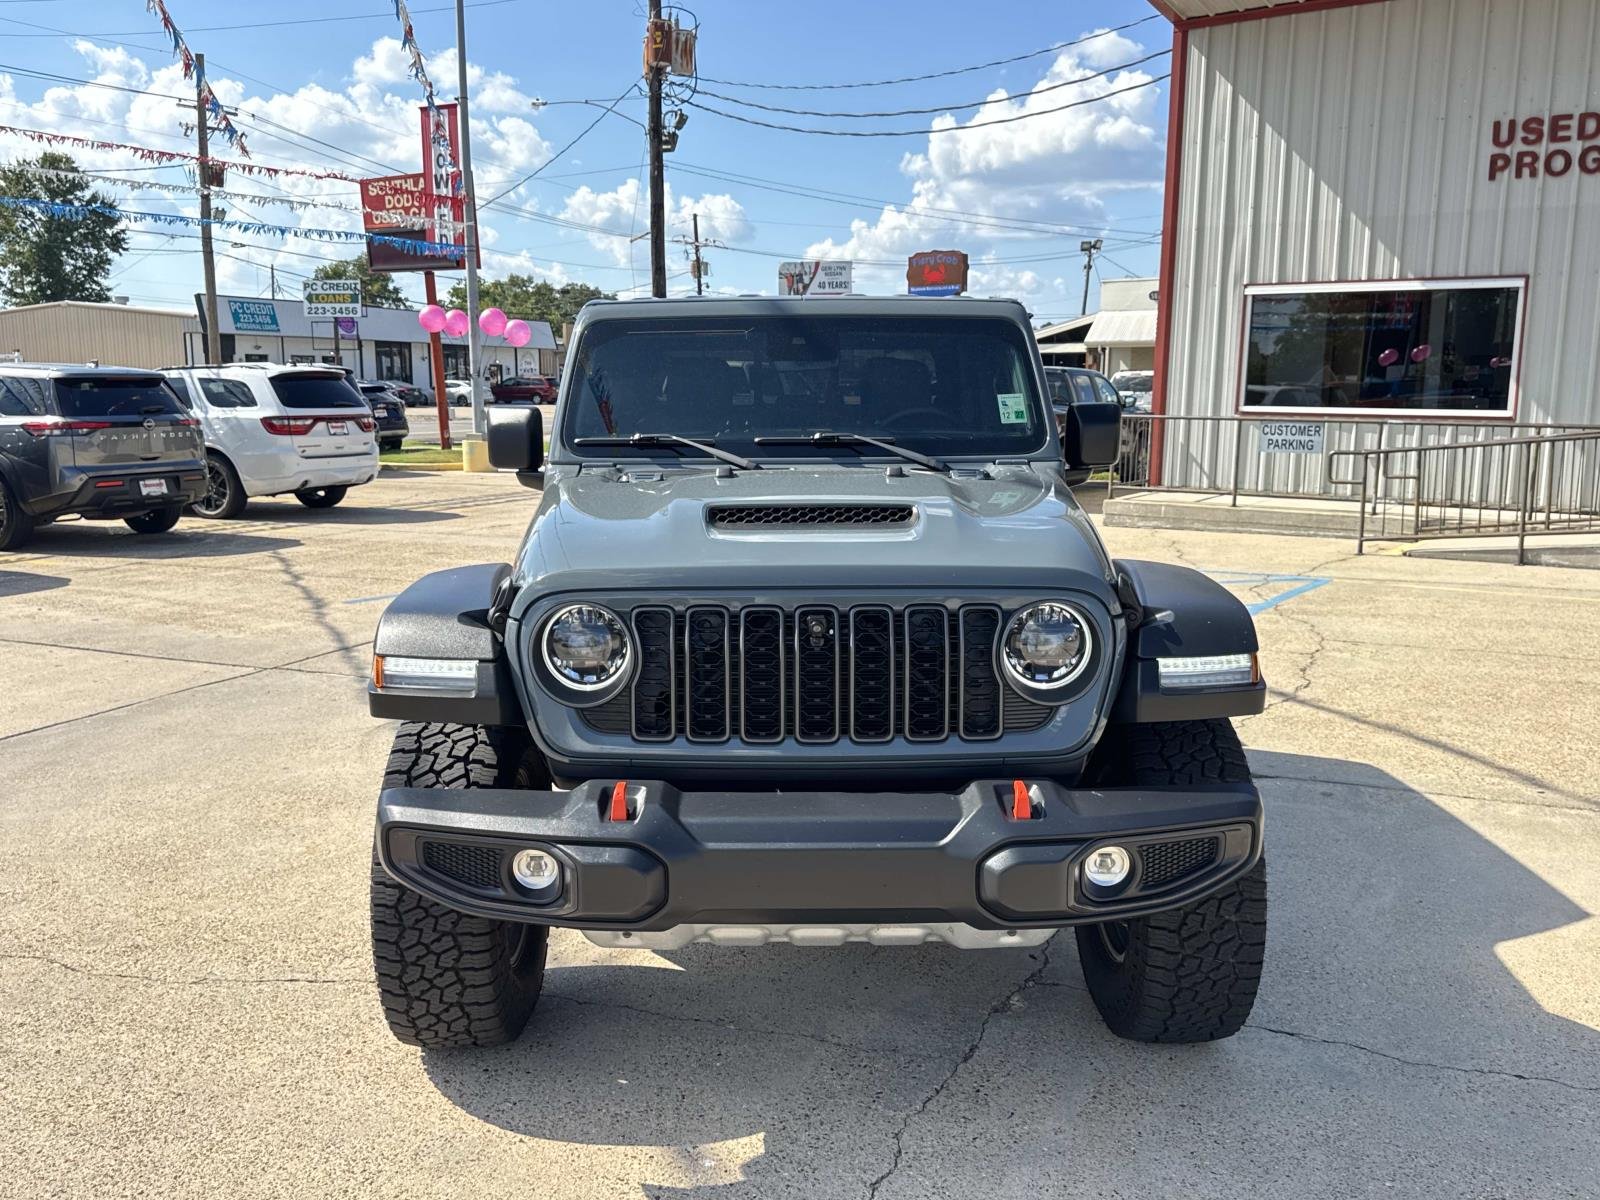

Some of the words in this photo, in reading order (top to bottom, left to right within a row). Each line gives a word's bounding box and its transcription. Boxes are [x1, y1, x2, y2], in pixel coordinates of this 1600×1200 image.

[1492, 112, 1600, 148] USED
[303, 282, 318, 291] PC
[321, 282, 359, 291] CREDIT
[818, 281, 826, 289] 40
[312, 294, 351, 303] LOANS
[230, 302, 243, 313] PC
[244, 303, 274, 316] CREDIT
[307, 306, 358, 315] 223-3456
[239, 314, 272, 324] 223-3456
[1002, 411, 1010, 419] 12
[1262, 424, 1322, 437] CUSTOMER
[100, 431, 191, 441] PATHFINDER
[1267, 438, 1314, 451] PARKING
